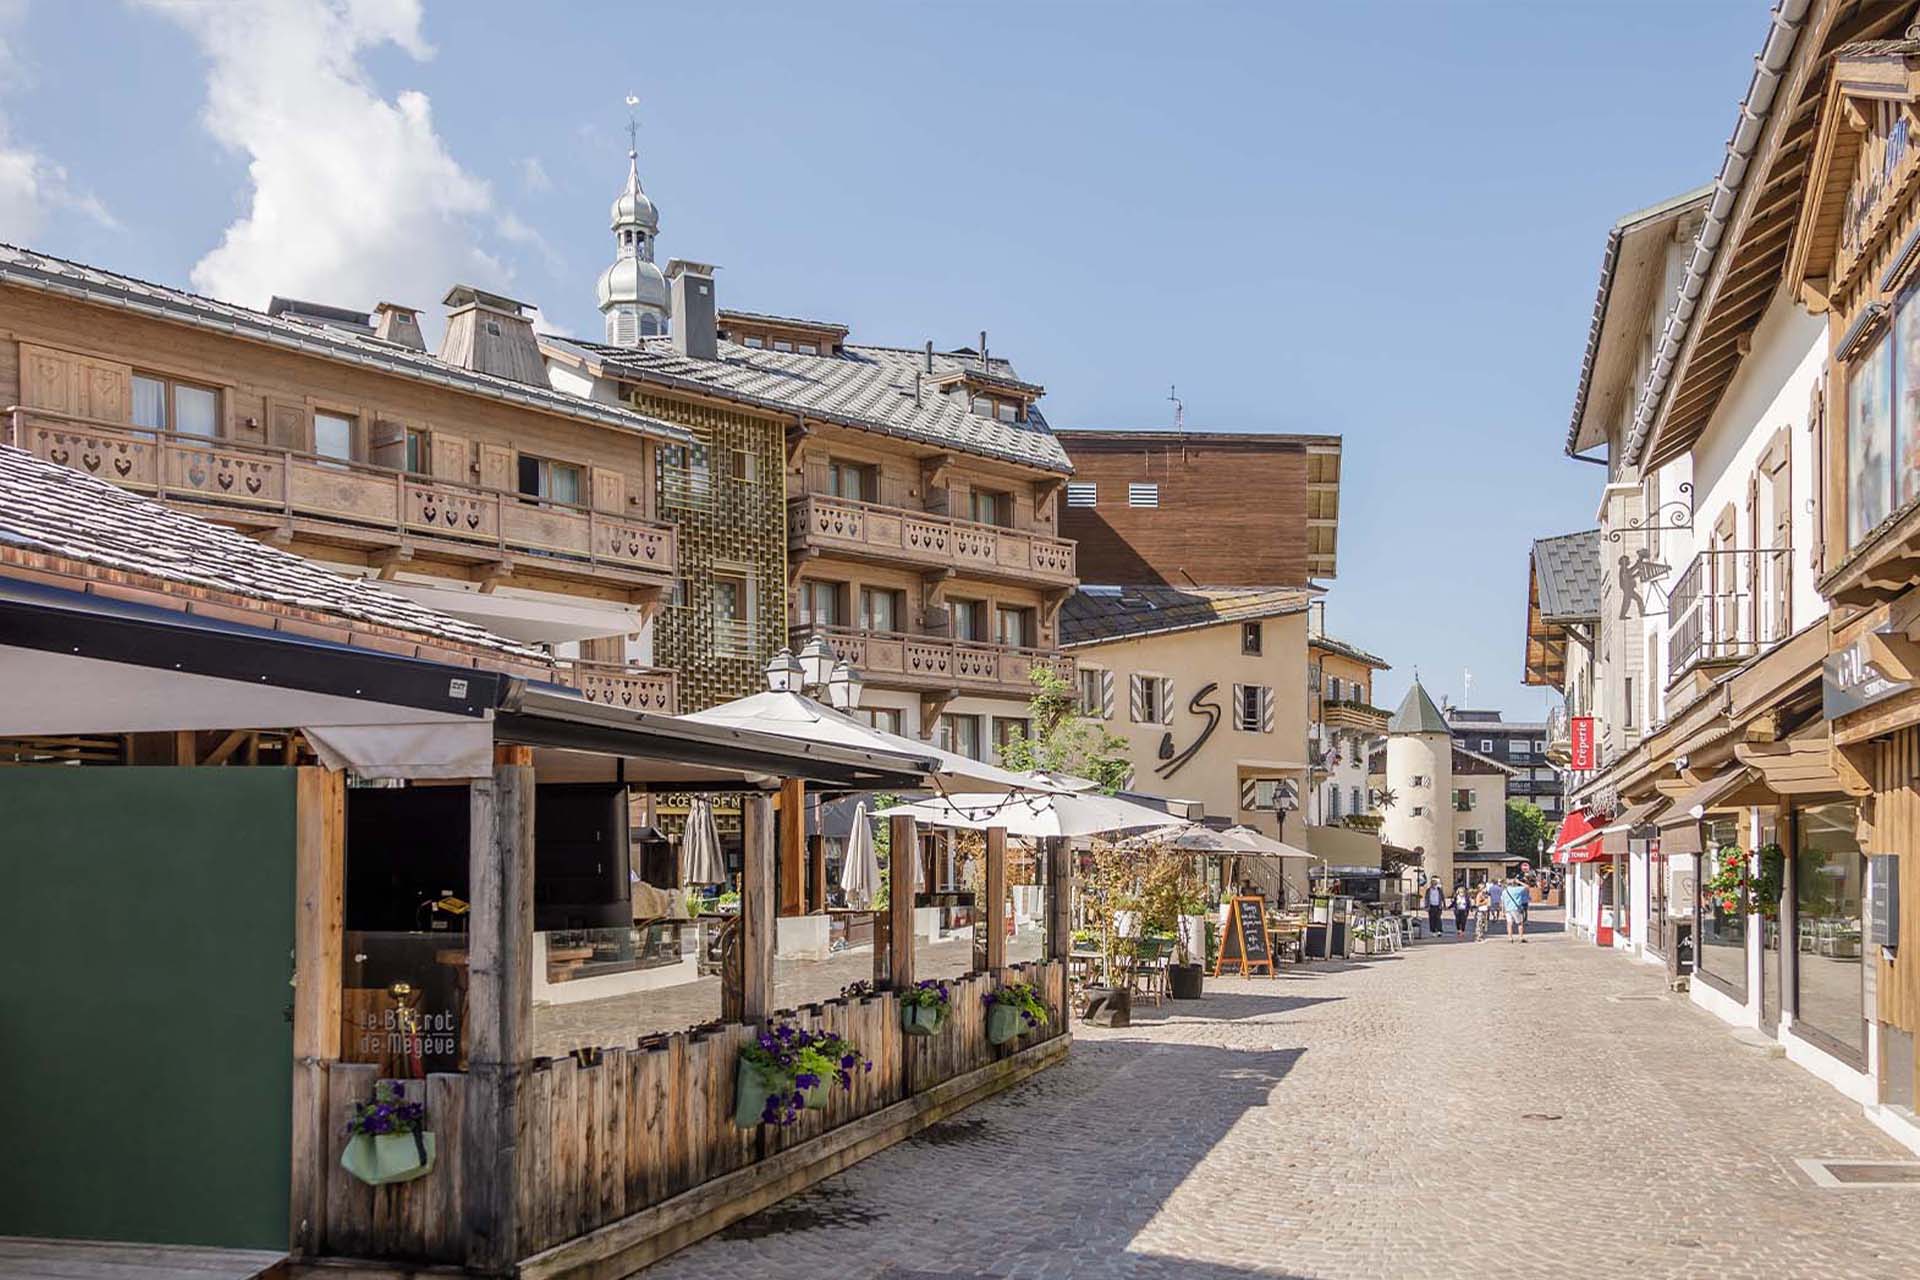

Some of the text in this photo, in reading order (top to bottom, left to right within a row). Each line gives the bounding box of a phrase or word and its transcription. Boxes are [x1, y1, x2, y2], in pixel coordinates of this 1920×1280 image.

[1576, 721, 1590, 766] Crêperie
[384, 1008, 455, 1030] Btrot
[361, 1034, 380, 1054] de
